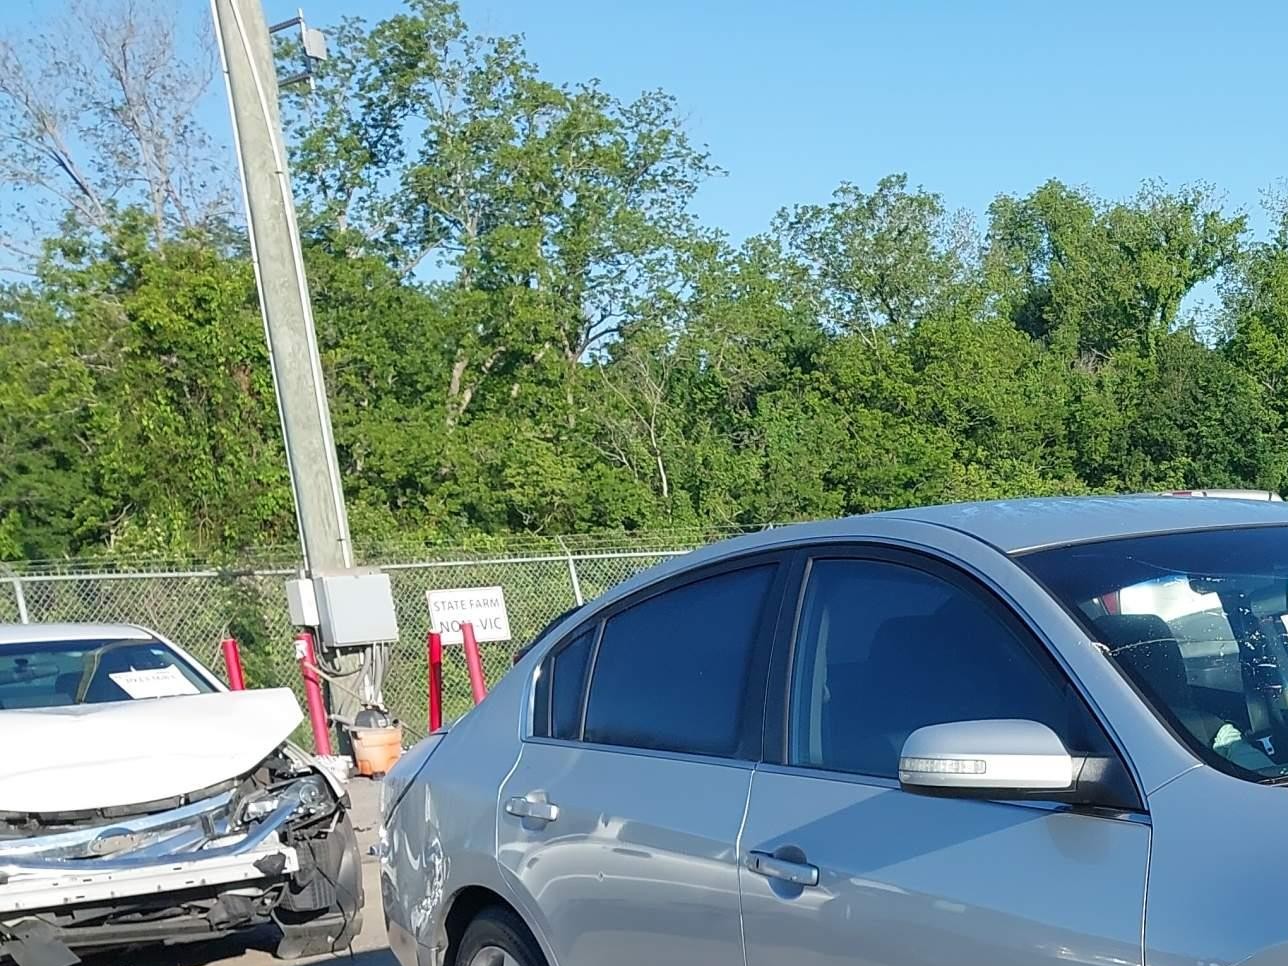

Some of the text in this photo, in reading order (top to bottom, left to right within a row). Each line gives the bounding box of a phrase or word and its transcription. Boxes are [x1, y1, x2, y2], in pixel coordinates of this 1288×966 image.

[432, 597, 500, 612] STATE FARM
[439, 616, 503, 634] NO-VIC
